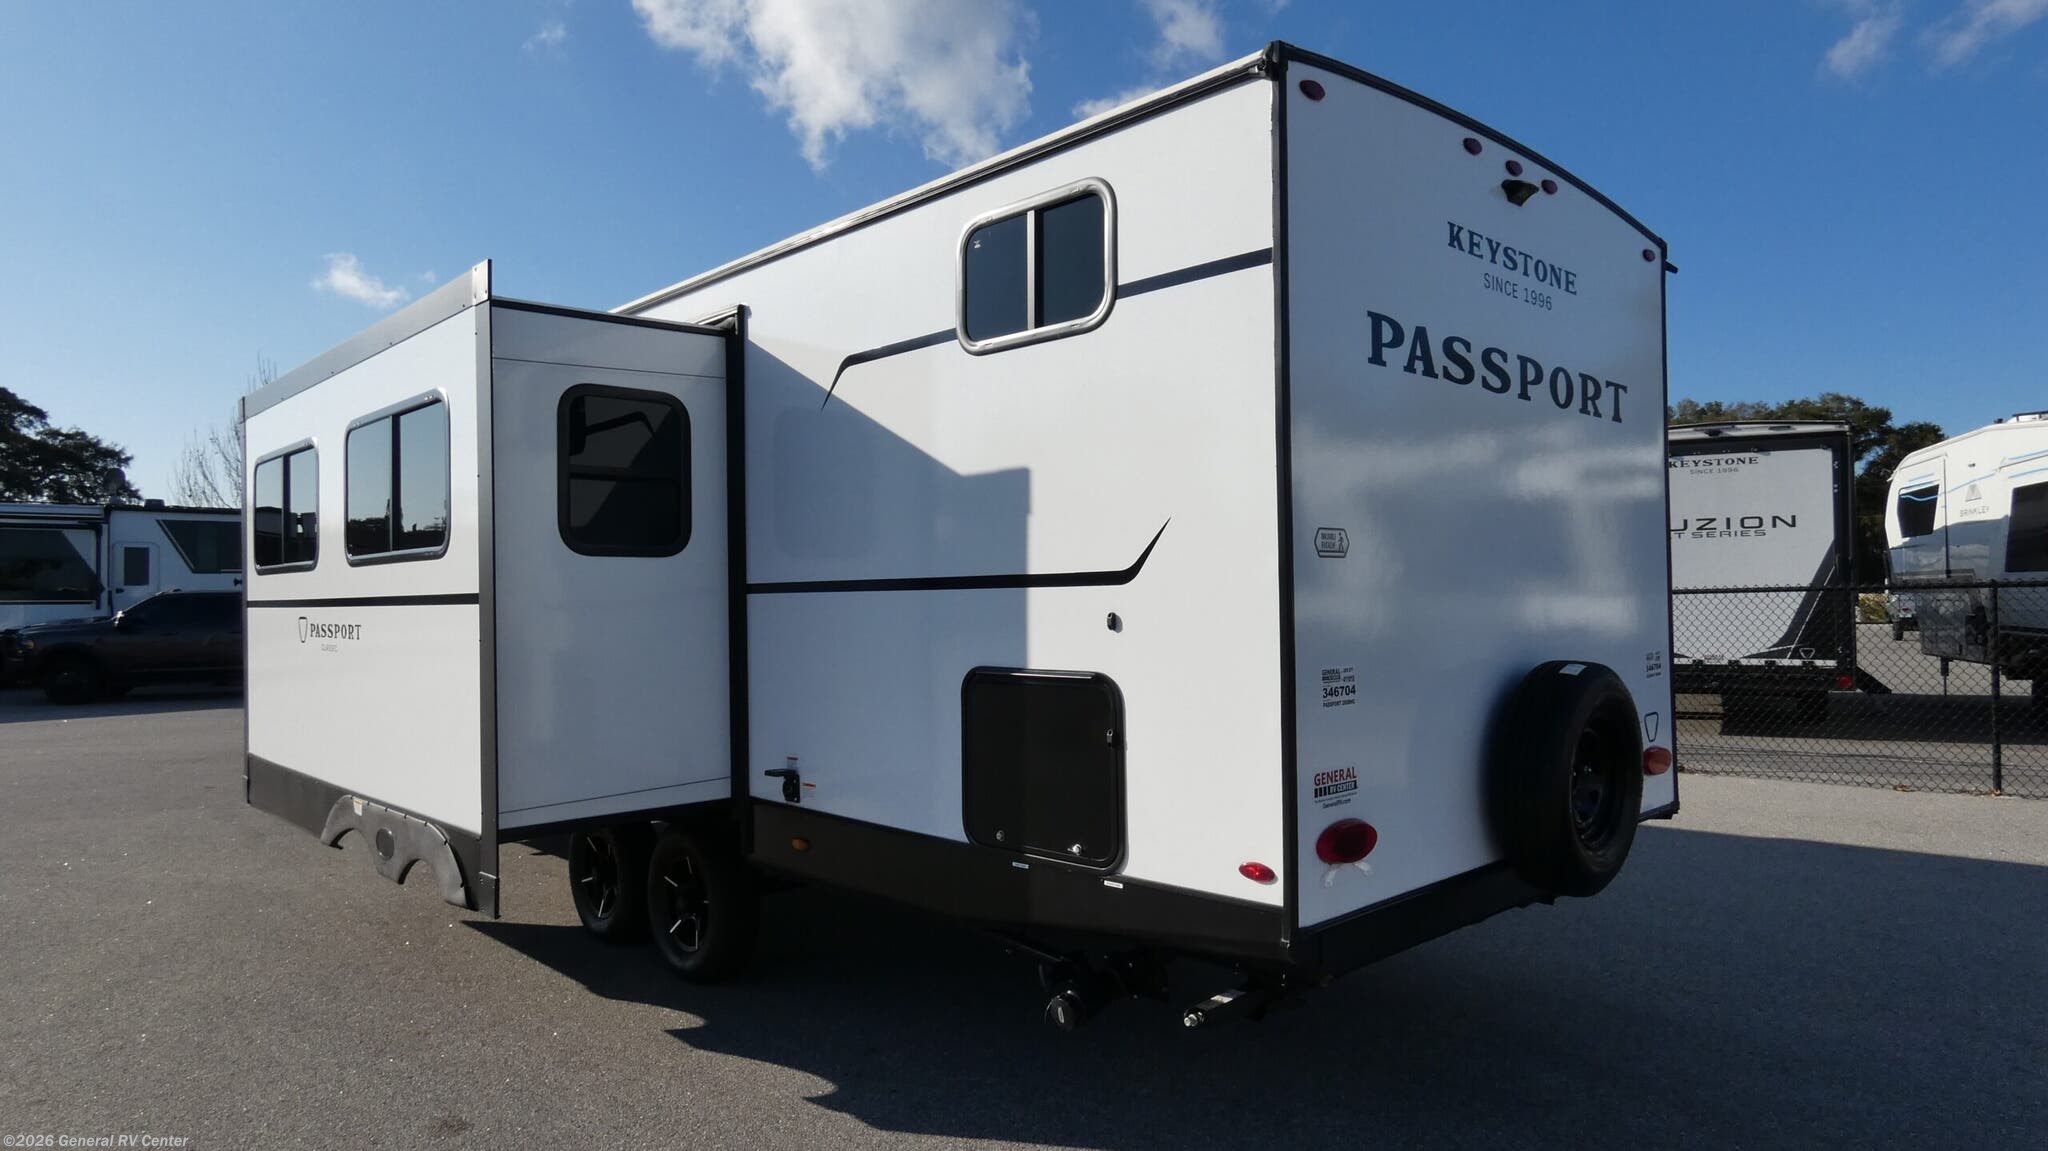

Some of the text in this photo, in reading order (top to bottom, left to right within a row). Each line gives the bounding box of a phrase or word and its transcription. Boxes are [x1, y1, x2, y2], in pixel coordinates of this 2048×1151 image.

[1447, 221, 1577, 296] KEYSTONE
[1483, 272, 1553, 311] SINCE 1996
[1367, 310, 1628, 423] PASSPORT
[1668, 456, 1759, 469] KEYSTONE
[1670, 515, 1797, 532] UZION
[1691, 529, 1767, 539] SERIES
[310, 623, 361, 640] PASSPORT
[1322, 684, 1356, 699] 346704
[1314, 766, 1357, 787] GENERAL
